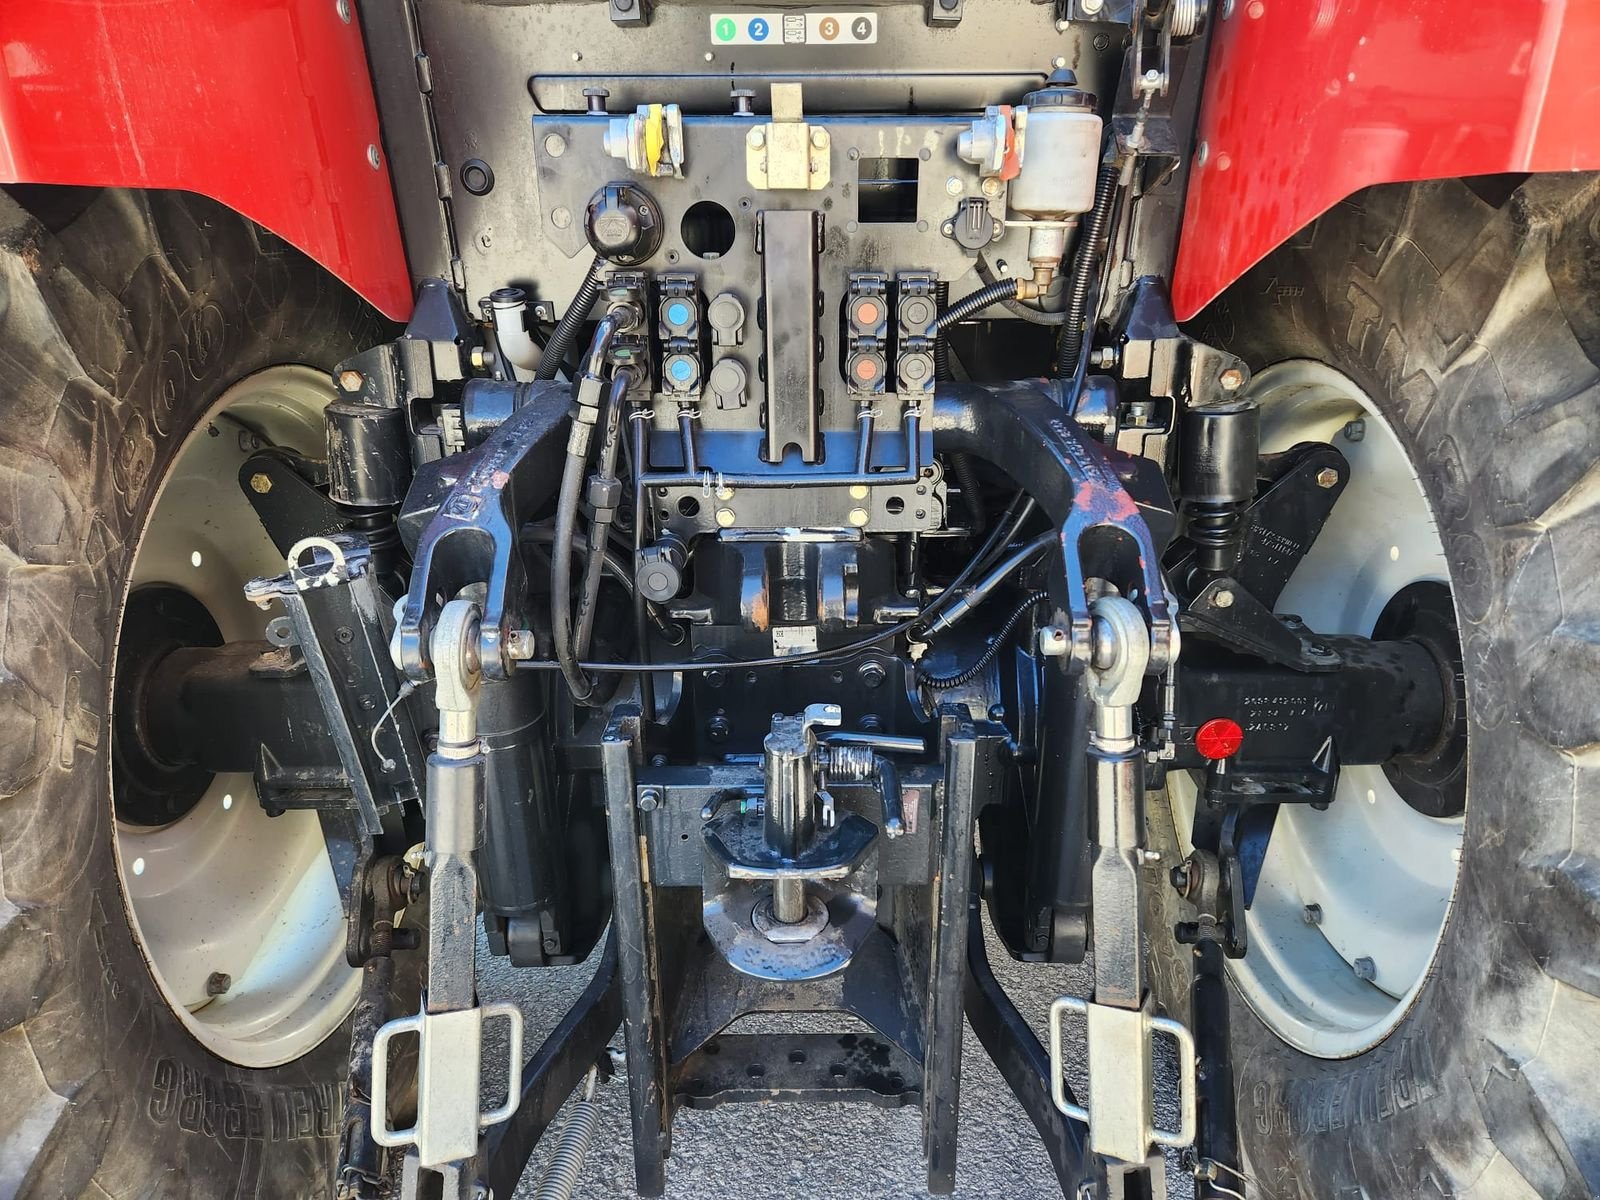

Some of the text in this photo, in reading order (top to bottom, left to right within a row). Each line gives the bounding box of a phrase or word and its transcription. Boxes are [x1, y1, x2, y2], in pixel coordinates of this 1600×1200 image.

[722, 22, 867, 36] 1 2 3 4
